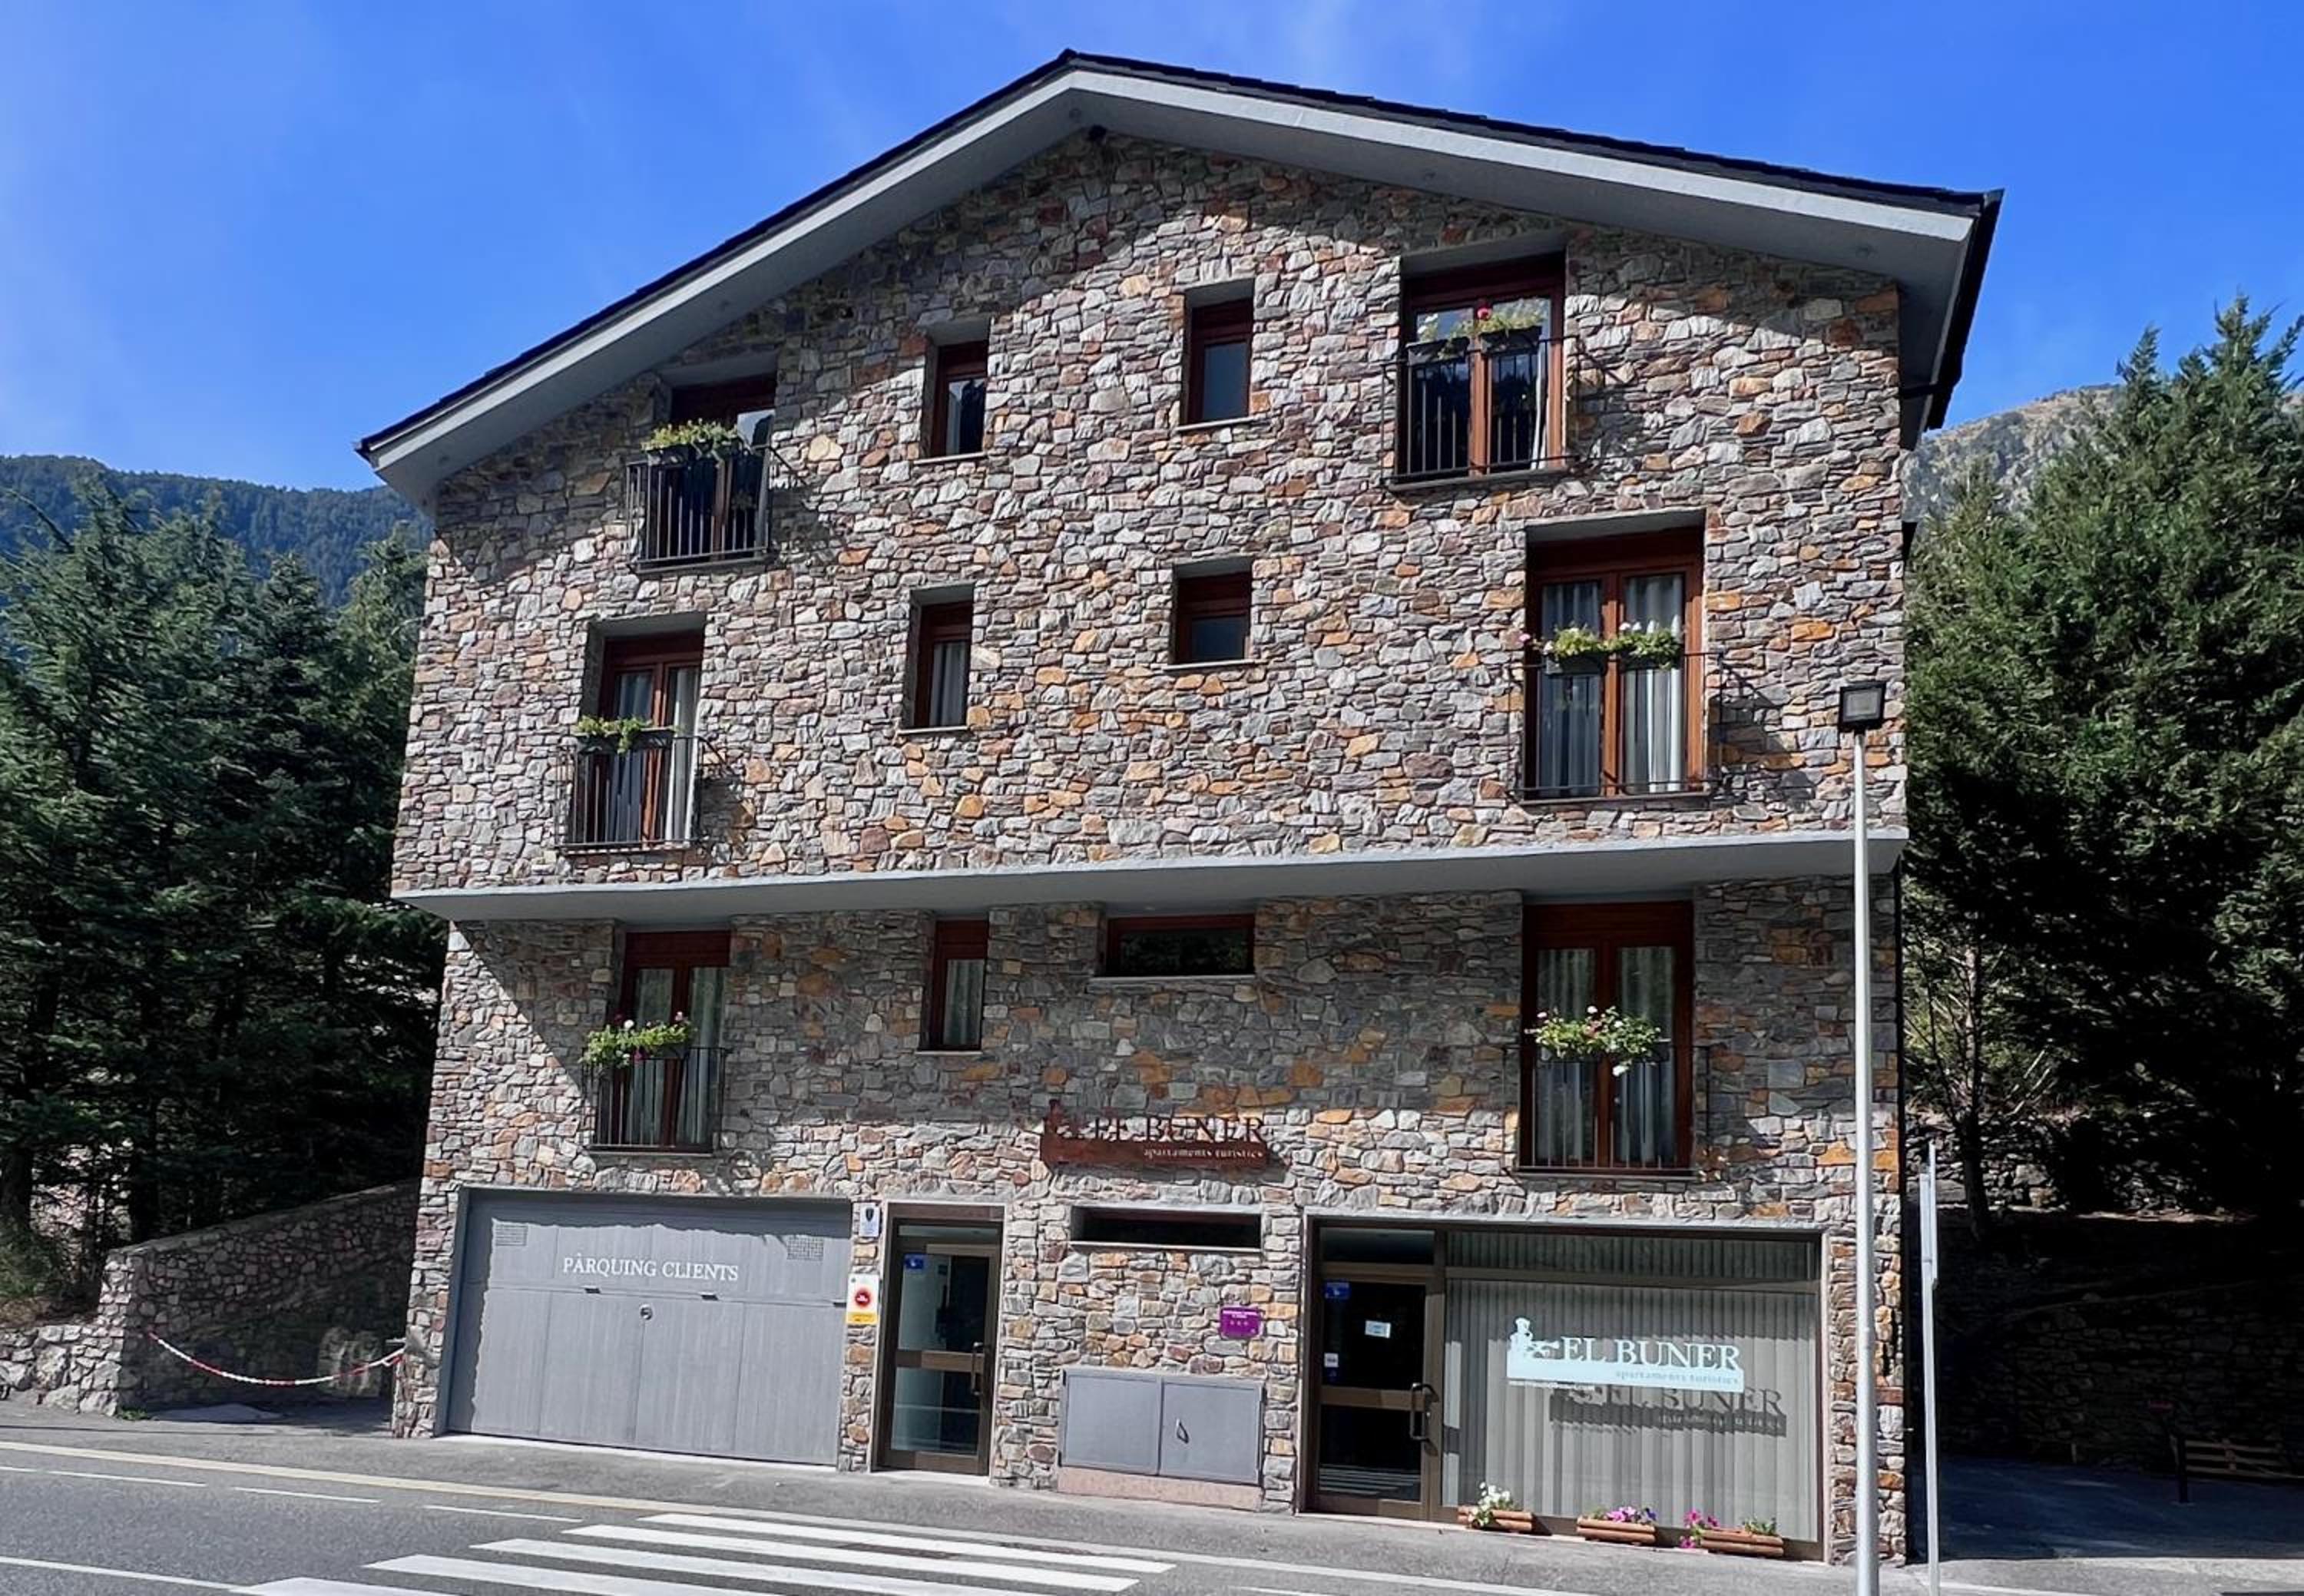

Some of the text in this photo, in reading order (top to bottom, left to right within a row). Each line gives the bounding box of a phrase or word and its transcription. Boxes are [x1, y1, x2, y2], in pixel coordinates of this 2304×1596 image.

[563, 1253, 738, 1281] PÀRQUING CLIENTS
[1561, 1336, 1742, 1370] EL BUNER
